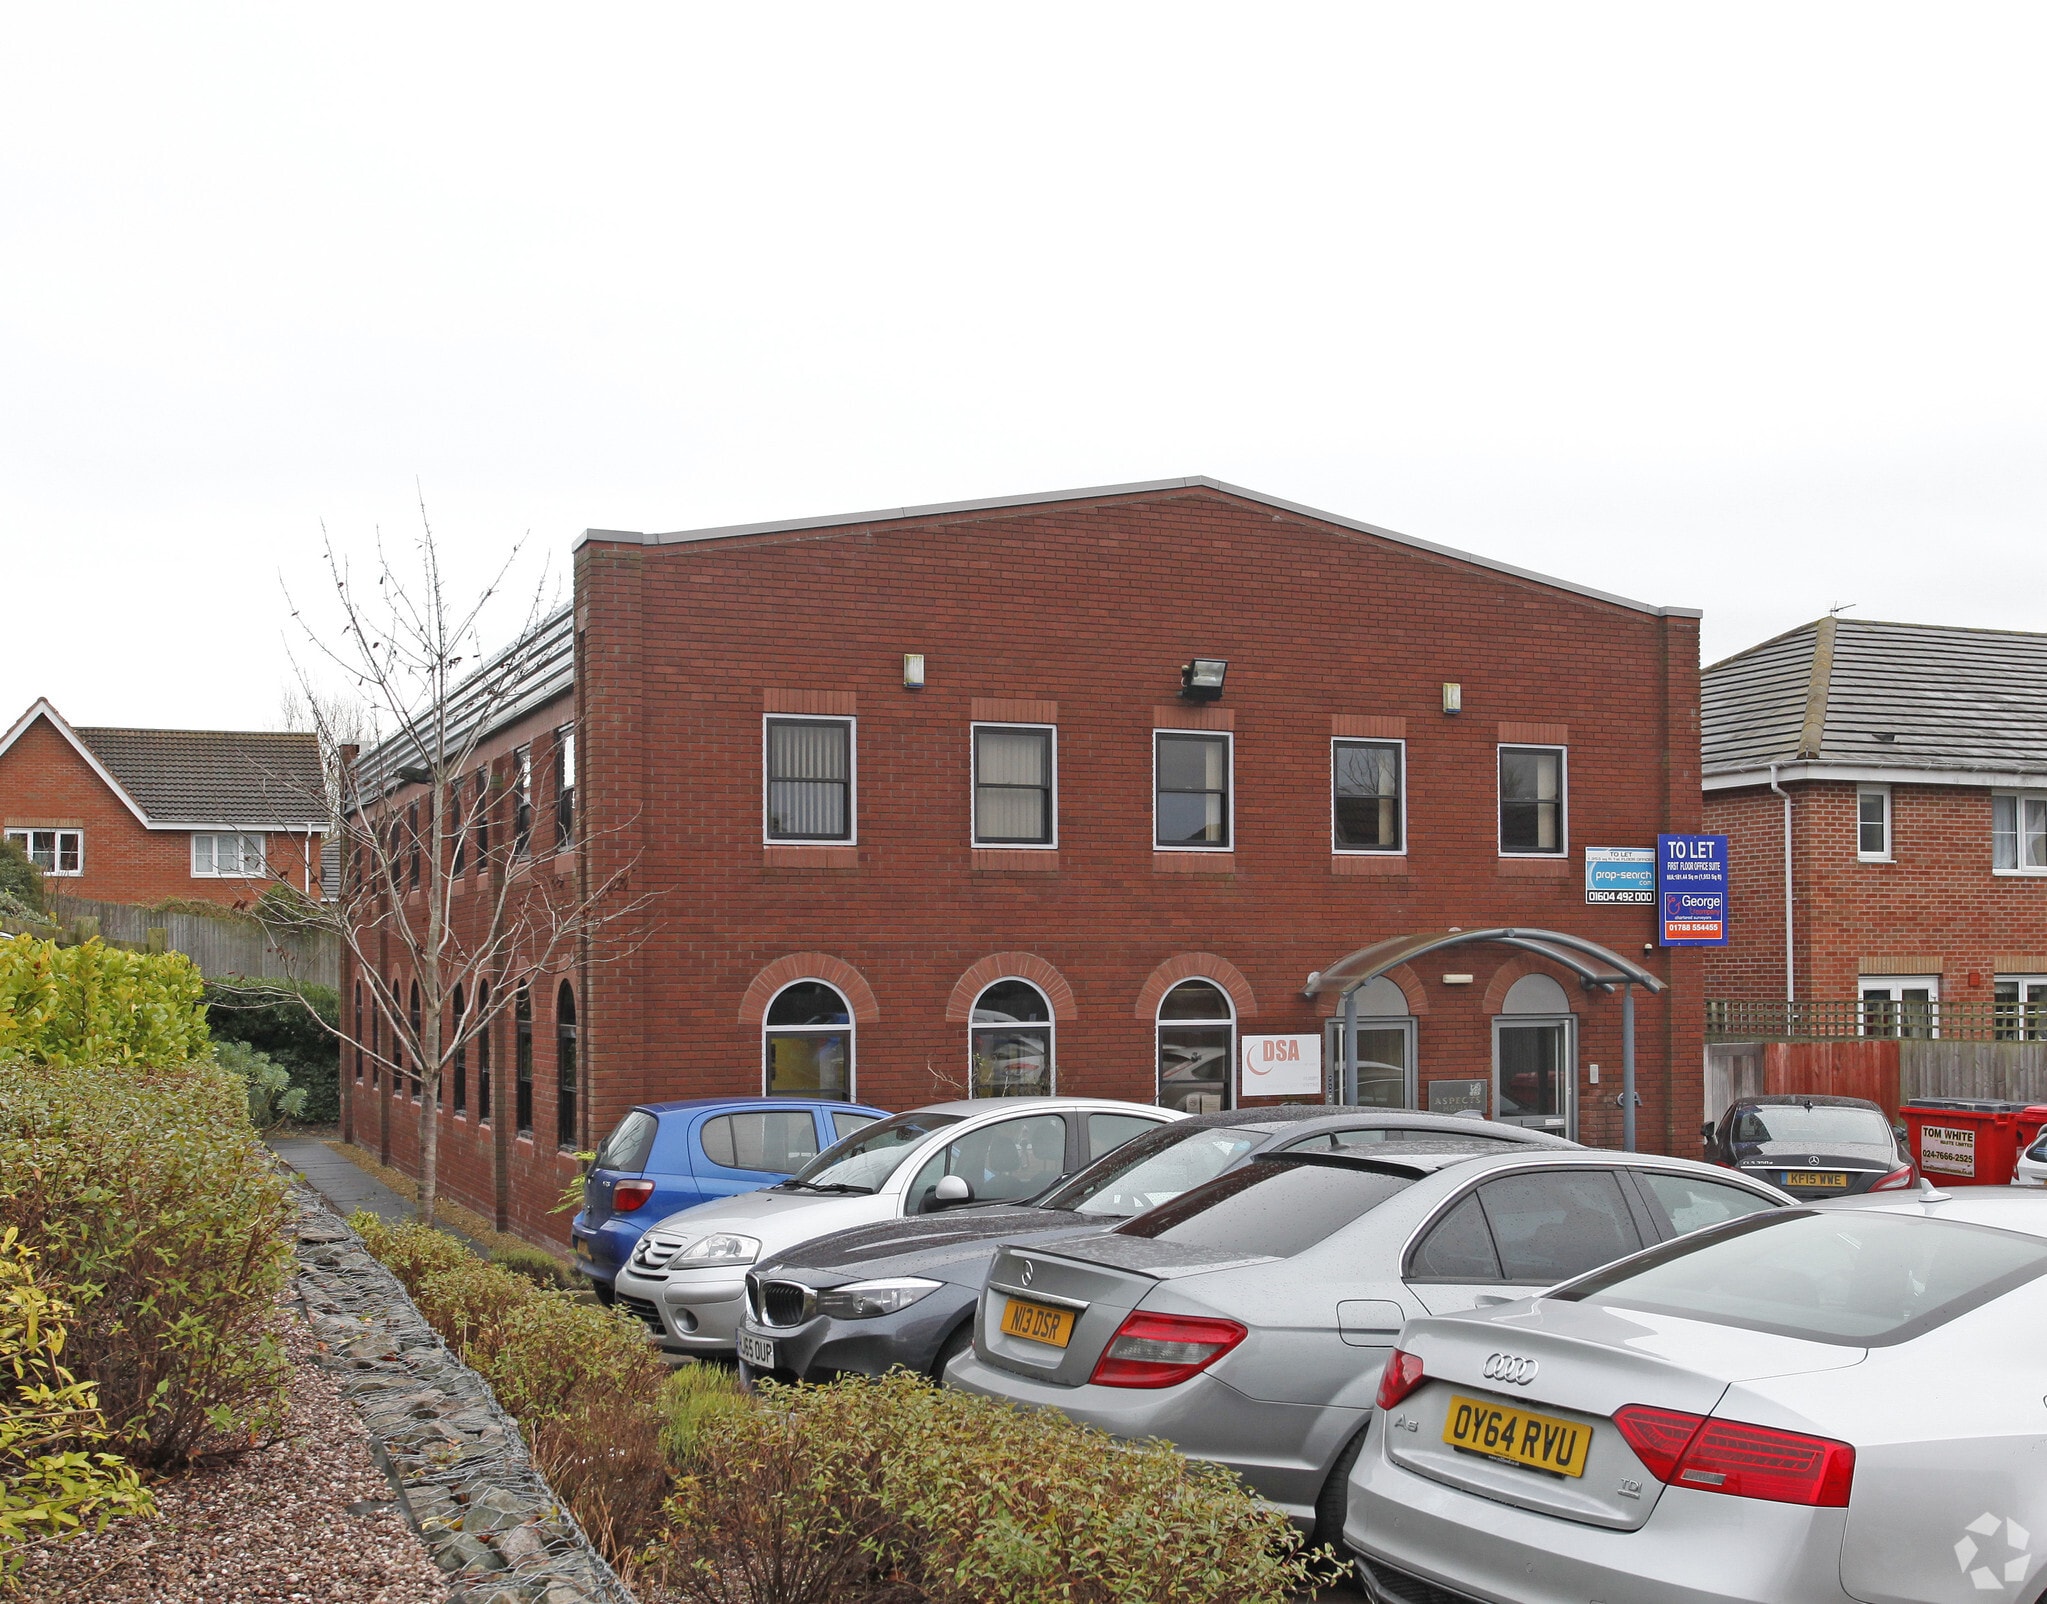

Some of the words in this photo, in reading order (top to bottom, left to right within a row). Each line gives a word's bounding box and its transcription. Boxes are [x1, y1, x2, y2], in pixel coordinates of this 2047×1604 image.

[1667, 841, 1686, 859] TO
[1690, 841, 1715, 859] LET
[1667, 861, 1679, 871] FIRST
[1680, 861, 1694, 871] FLOOR
[1694, 861, 1708, 871] OFFICE
[1708, 861, 1720, 871] SUITE
[1595, 871, 1652, 882] prop-search
[1588, 891, 1616, 902] 01604
[1616, 891, 1634, 902] 492
[1634, 891, 1653, 902] 000
[1681, 894, 1721, 910] George
[1669, 923, 1691, 931] 01788
[1692, 923, 1718, 931] 554455
[1262, 1039, 1300, 1062] DSA
[1434, 1096, 1481, 1105] ASPECTS
[1923, 1126, 1942, 1139] TOM
[1944, 1130, 1974, 1142] WHITE
[1955, 1141, 1974, 1149] LIMITED
[1790, 1173, 1817, 1184] KF15
[1819, 1175, 1842, 1185] WWE
[1010, 1305, 1034, 1333] N13
[1032, 1310, 1061, 1340] DSR
[754, 1340, 772, 1363] OUP
[1394, 1413, 1419, 1433] A5
[1453, 1404, 1518, 1453] OY64
[1520, 1419, 1577, 1466] RVU
[1620, 1477, 1642, 1494] TDI
